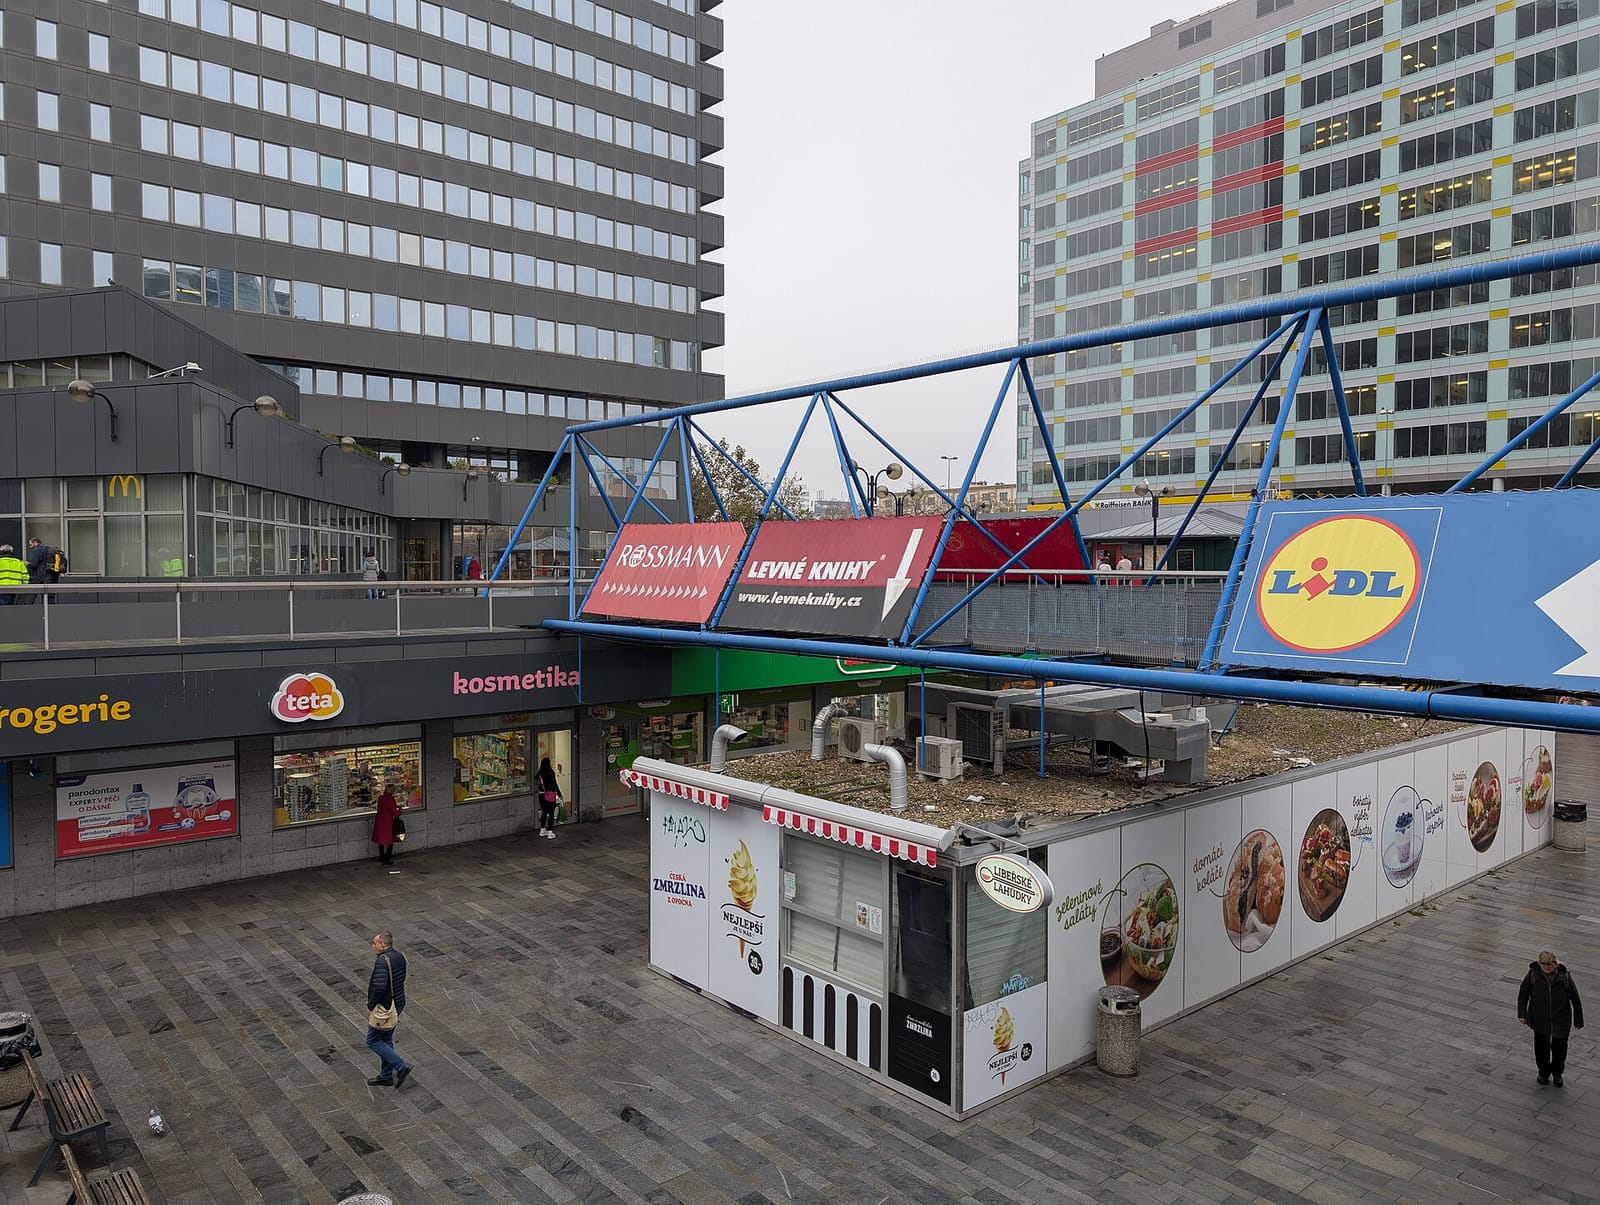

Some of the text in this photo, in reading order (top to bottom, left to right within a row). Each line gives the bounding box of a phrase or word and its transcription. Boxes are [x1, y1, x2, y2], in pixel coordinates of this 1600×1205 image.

[1100, 499, 1153, 509] Raiffeisen BANK
[616, 544, 731, 569] ROSSMANN
[747, 556, 877, 580] LEVNÉ KNIHY
[738, 591, 863, 609] www.levneknihy.cz
[453, 665, 581, 695] kosmetika
[286, 691, 334, 712] teta
[68, 786, 120, 800] parodontax
[69, 798, 96, 807] EXPERT
[1193, 841, 1225, 874] domácí
[653, 878, 706, 899] ZMRZLINA
[993, 866, 1033, 889] LIBEŘSKÉ
[1055, 877, 1104, 922] zeleninové
[723, 911, 764, 936] NEJLEPŠÍ
[1063, 903, 1098, 930] saláty
